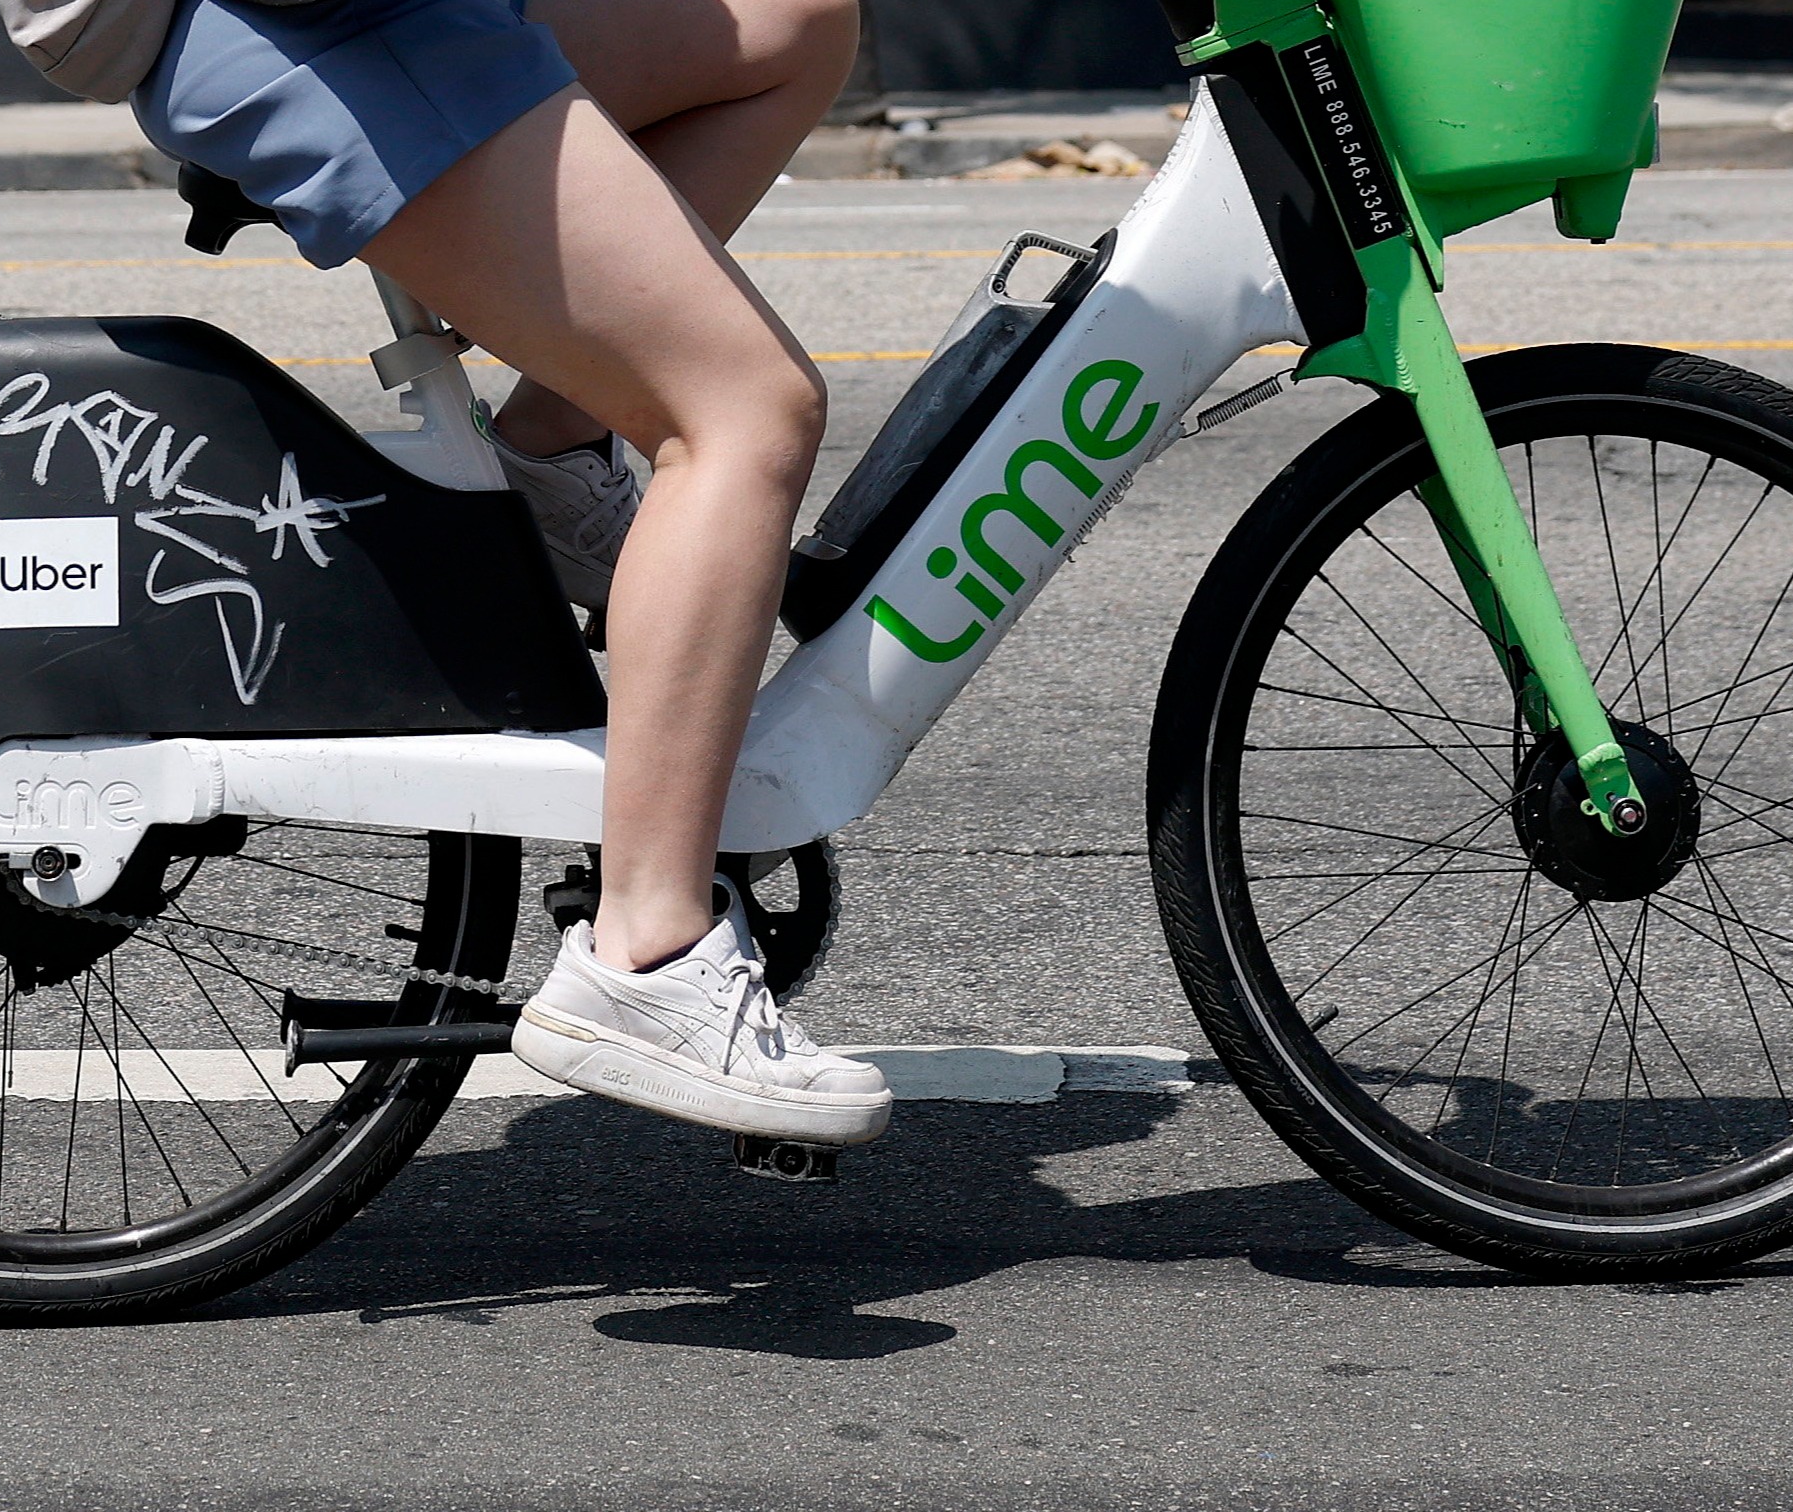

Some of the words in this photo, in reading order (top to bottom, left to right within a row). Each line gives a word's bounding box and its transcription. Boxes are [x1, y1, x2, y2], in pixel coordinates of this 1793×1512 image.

[1304, 44, 1337, 95] LIME
[1325, 100, 1393, 234] 888.546.3345
[0, 555, 103, 592] Uber
[863, 358, 1161, 663] Lime
